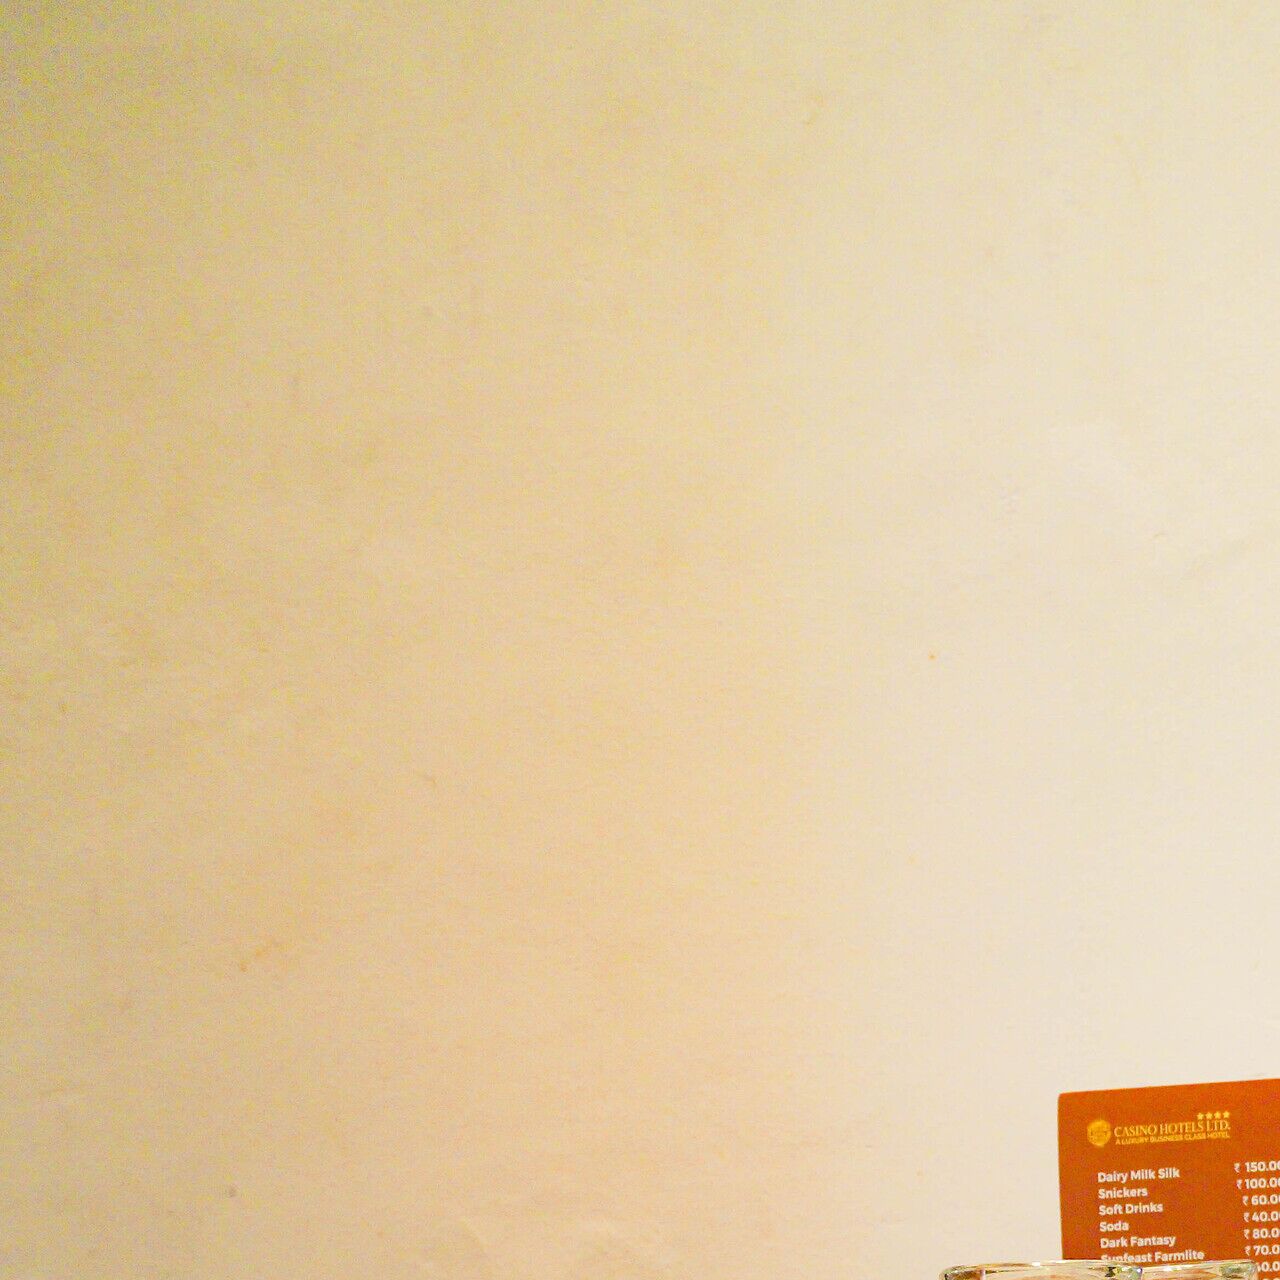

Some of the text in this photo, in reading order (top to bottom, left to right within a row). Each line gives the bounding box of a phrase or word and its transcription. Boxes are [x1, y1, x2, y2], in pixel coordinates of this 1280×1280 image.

[1114, 1124, 1158, 1138] CASINO
[1159, 1120, 1204, 1135] HOTELS
[1097, 1167, 1181, 1184] Dairy Milk Silk
[1098, 1187, 1148, 1199] Snickers
[1099, 1202, 1163, 1216] Soft Drinks
[1100, 1221, 1129, 1232] Soda
[1100, 1235, 1176, 1249] Dark Fantasy
[1154, 1249, 1205, 1261] Farmlite
